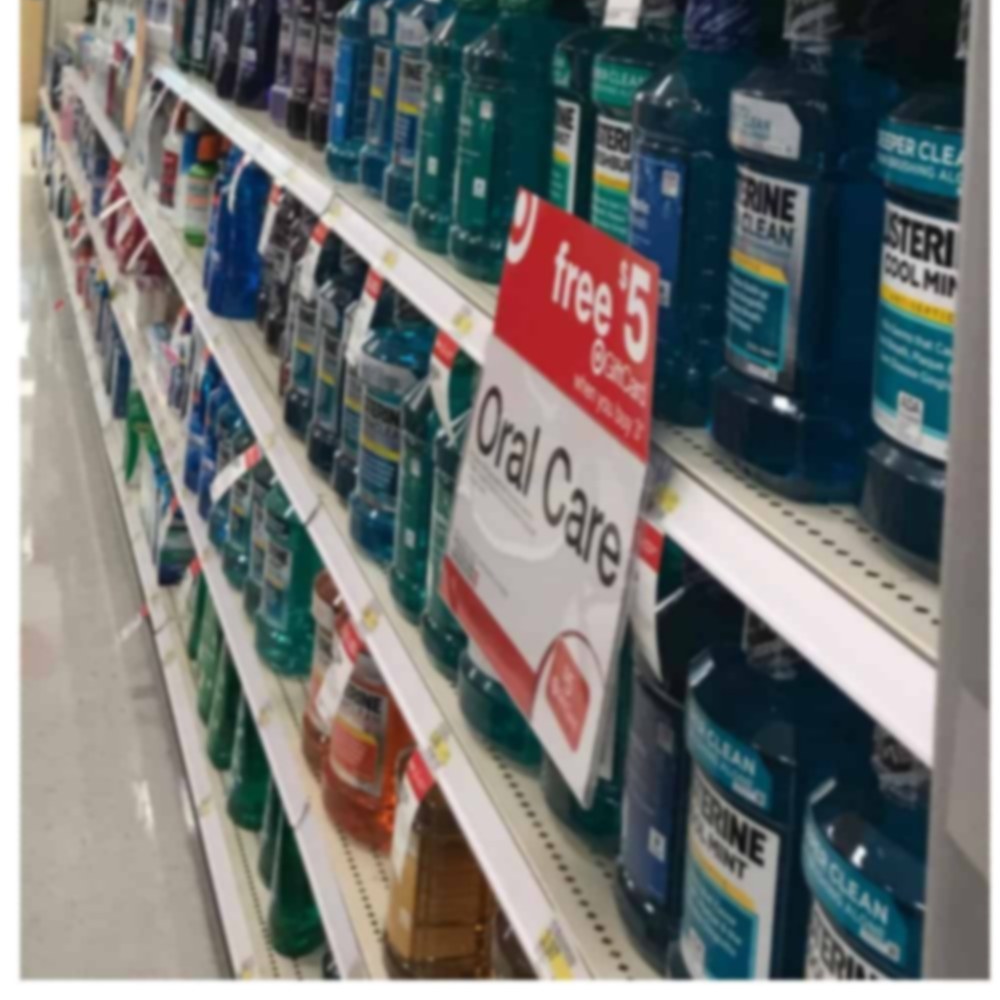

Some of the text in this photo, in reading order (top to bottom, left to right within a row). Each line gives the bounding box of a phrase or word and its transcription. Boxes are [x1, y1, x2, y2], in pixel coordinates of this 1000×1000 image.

[552, 240, 613, 336] free
[476, 385, 541, 497] Oral
[543, 446, 621, 588] Care
